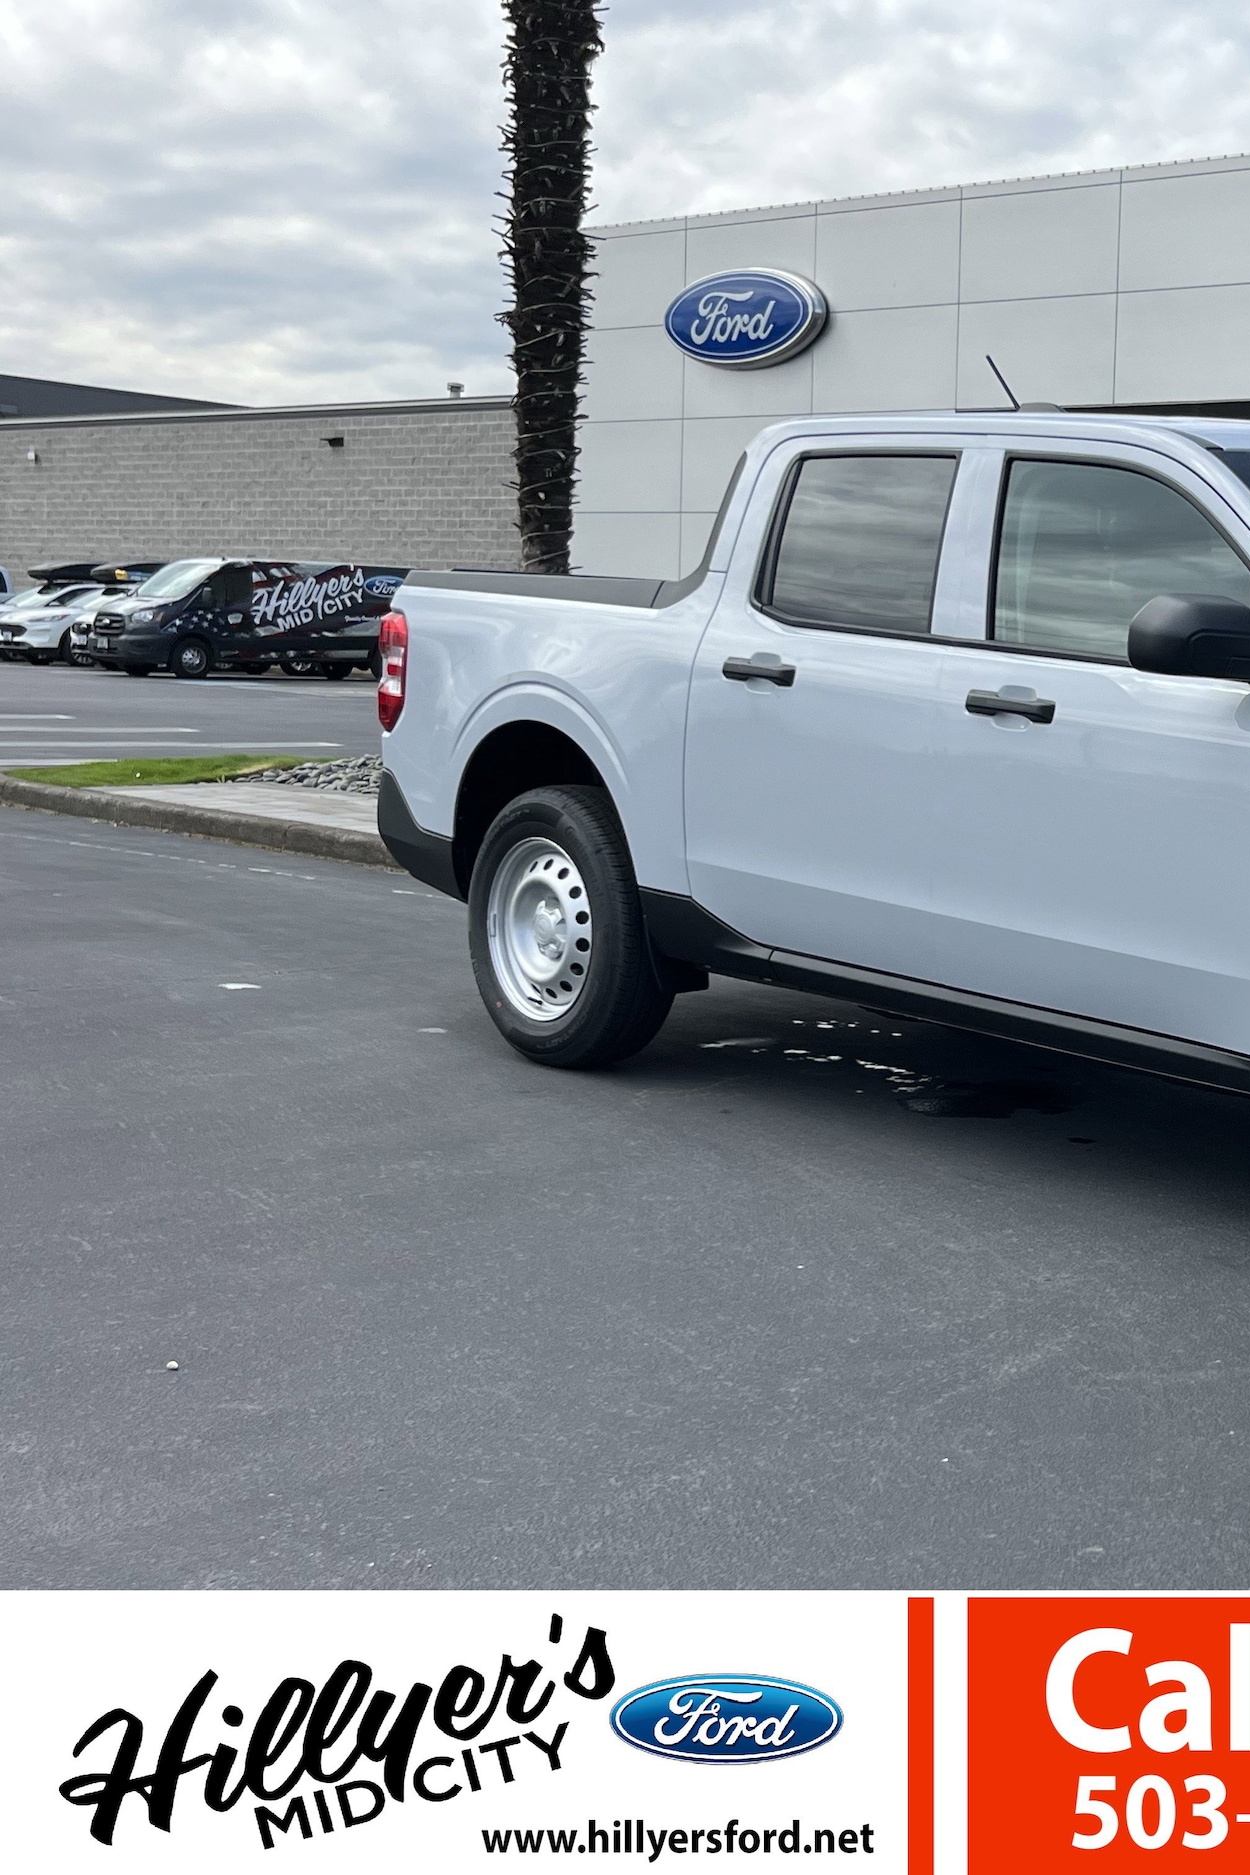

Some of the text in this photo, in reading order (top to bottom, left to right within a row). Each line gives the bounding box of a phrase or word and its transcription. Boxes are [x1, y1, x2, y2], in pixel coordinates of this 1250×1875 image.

[690, 290, 776, 345] Ford
[251, 564, 365, 625] Hillyer's
[277, 588, 363, 631] MID CITY
